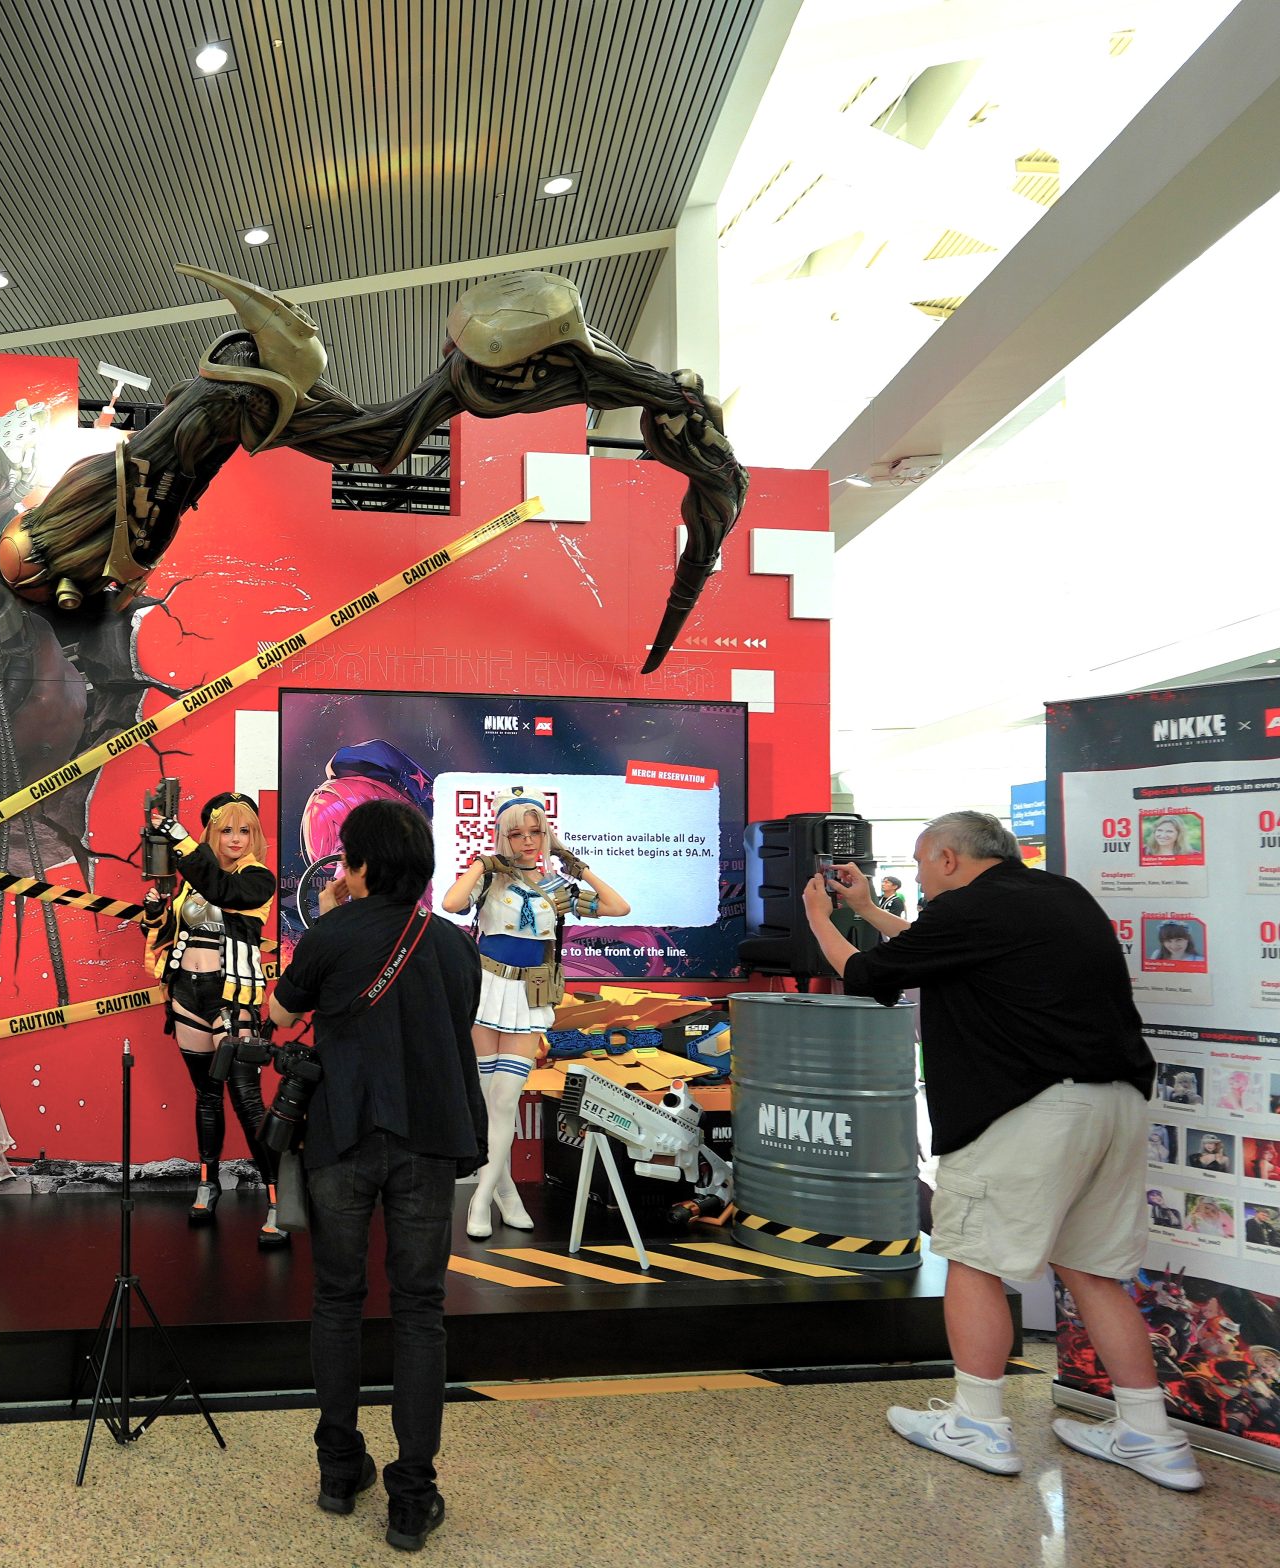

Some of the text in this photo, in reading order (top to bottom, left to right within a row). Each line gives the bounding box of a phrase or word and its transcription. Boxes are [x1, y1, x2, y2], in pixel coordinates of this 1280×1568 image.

[401, 549, 451, 587] CAUTION
[330, 591, 380, 628] CAUTION
[256, 633, 307, 670] CAUTION
[182, 675, 233, 713] CAUTION
[484, 716, 552, 730] NIKKE AX
[1153, 715, 1226, 741] NIKKE
[106, 719, 158, 756] CAUTION
[29, 762, 81, 801] CAUTION
[631, 768, 705, 784] MERCH RESERVATION
[1181, 785, 1212, 794] Guest
[1213, 784, 1242, 792] drops
[564, 832, 706, 845] Reservation available all day
[1102, 817, 1132, 838] 03
[606, 847, 634, 856] ticket
[638, 847, 669, 858] begins
[672, 849, 683, 857] at
[685, 849, 714, 857] 9A.M.
[1102, 842, 1131, 853] JULY
[570, 947, 581, 957] to
[584, 947, 602, 957] the
[604, 947, 631, 957] front
[633, 947, 645, 957] of
[647, 947, 664, 957] the
[666, 947, 688, 957] line.
[368, 947, 407, 998] EOS 5D Mark IV
[96, 991, 151, 1016] CAUTION
[9, 1008, 65, 1034] CAUTION
[1157, 1029, 1198, 1039] amazing
[1200, 1031, 1256, 1042] cosplayers
[1258, 1034, 1278, 1043] live
[606, 1110, 632, 1130] 2000
[759, 1103, 852, 1146] NIKKE
